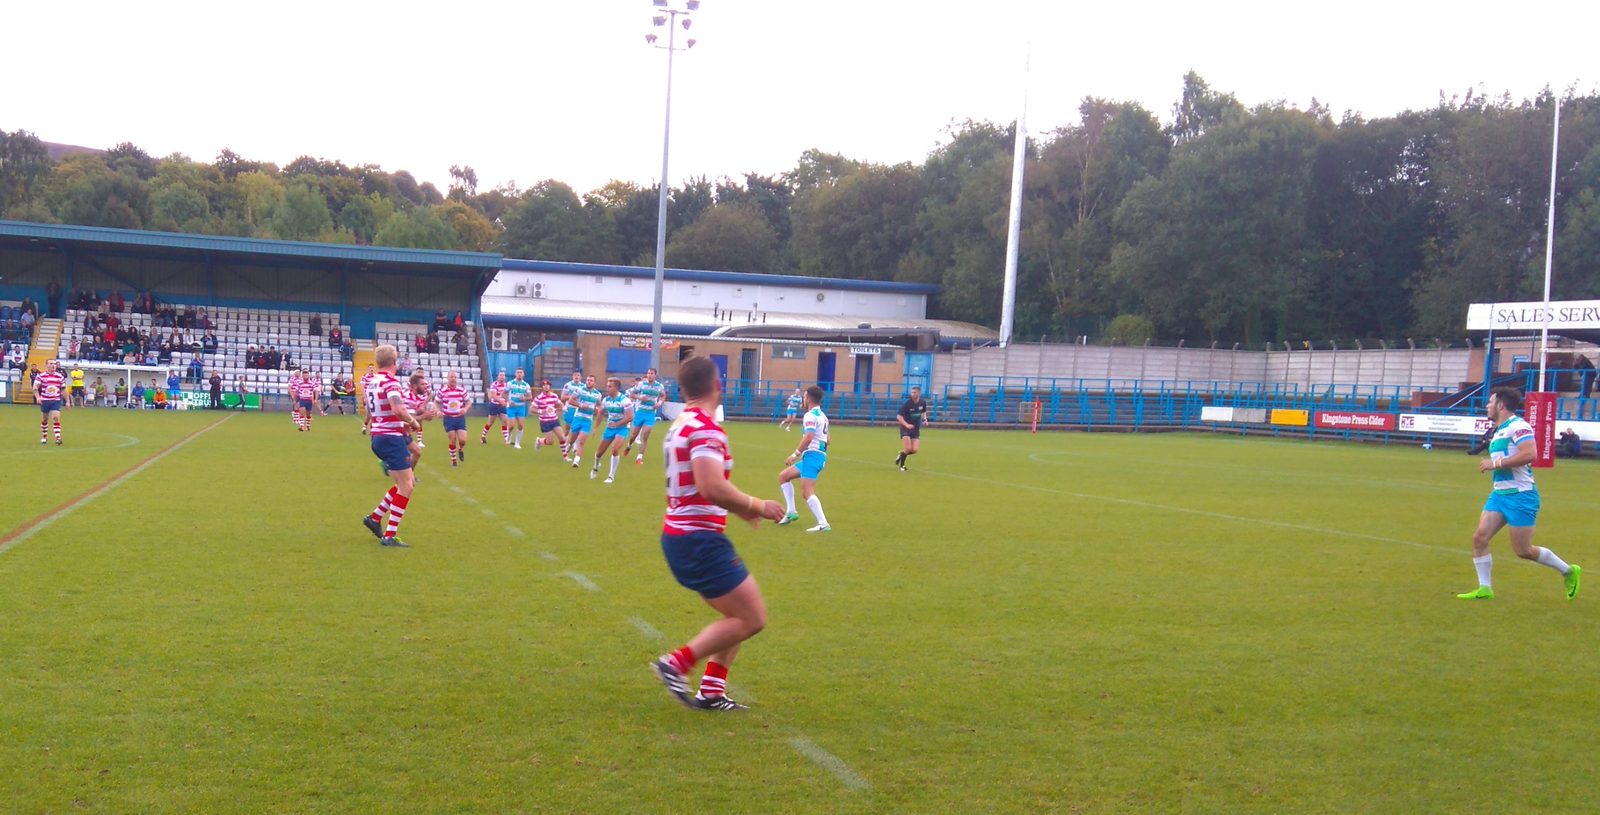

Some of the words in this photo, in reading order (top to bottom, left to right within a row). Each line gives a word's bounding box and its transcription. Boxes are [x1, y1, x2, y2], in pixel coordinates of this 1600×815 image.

[1497, 308, 1554, 323] SALES
[193, 392, 225, 401] OFFE
[1322, 413, 1352, 426] Kingstone
[1351, 414, 1369, 425] Press
[1368, 415, 1386, 426] Cider
[1542, 422, 1552, 460] Kingstone
